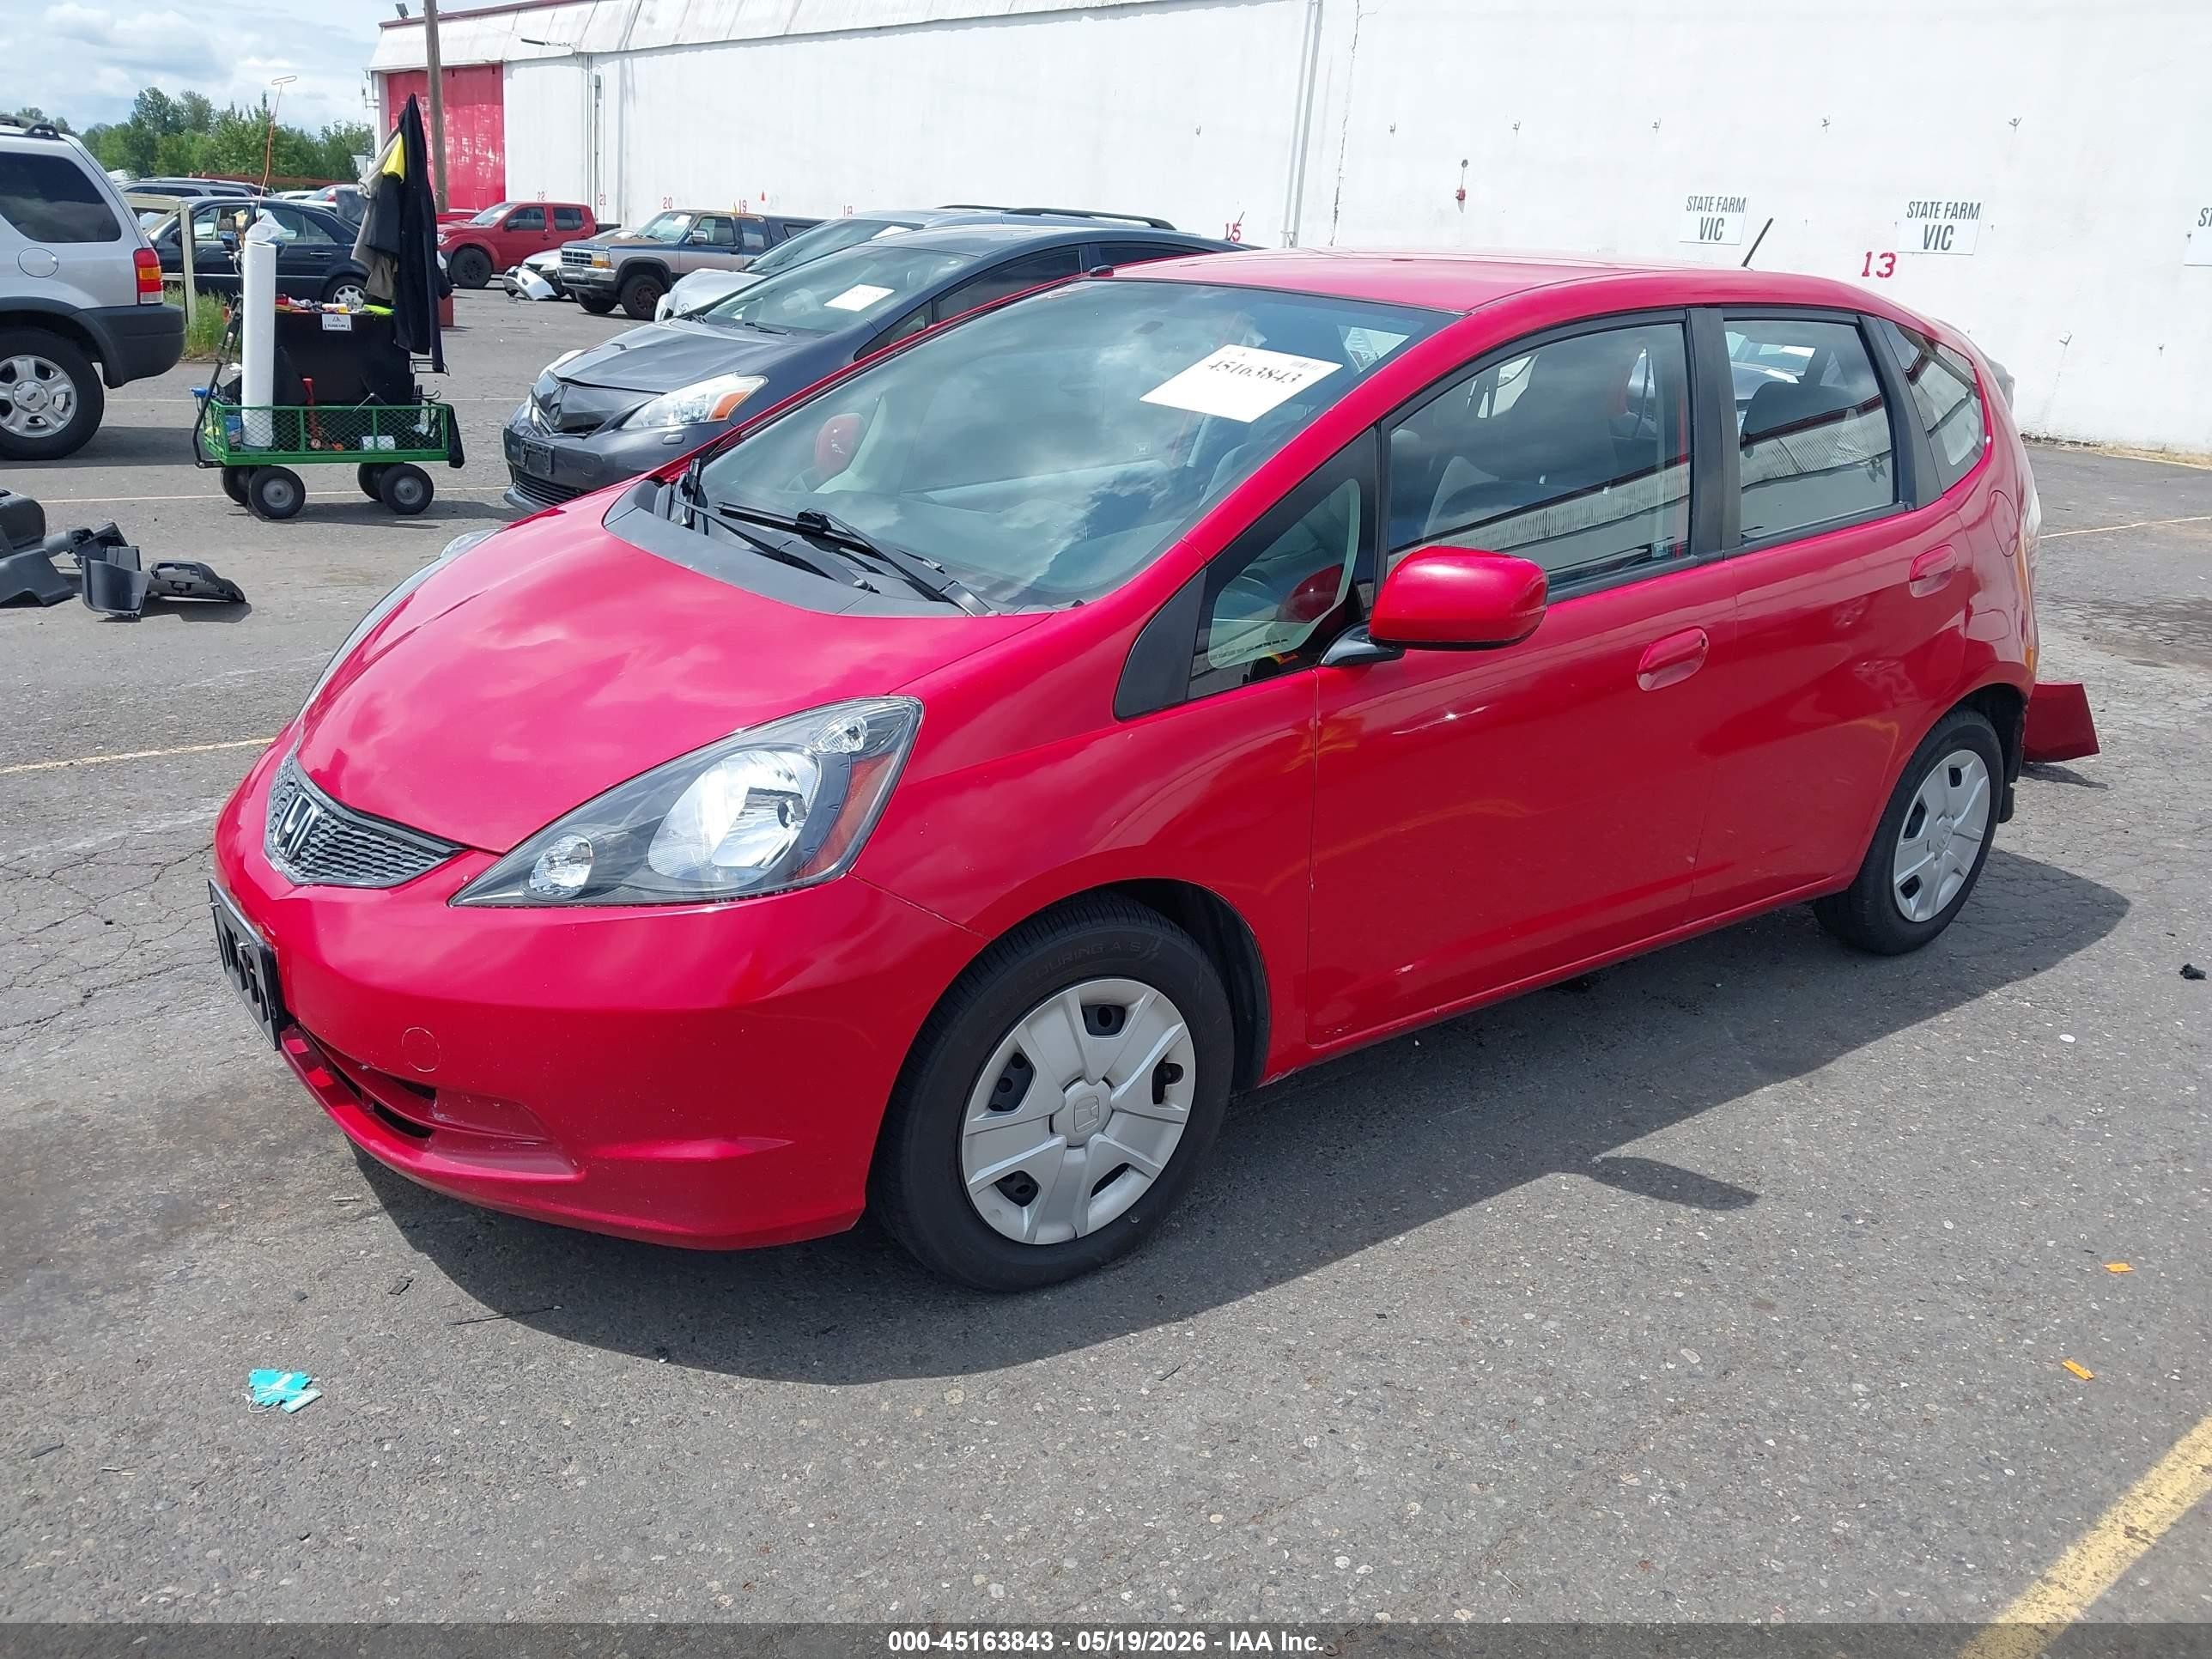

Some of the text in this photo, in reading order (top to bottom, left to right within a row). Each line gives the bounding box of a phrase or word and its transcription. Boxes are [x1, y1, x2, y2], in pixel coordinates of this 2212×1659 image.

[537, 191, 545, 201] 22
[662, 197, 673, 210] 20
[1686, 196, 1747, 213] STATE FARM
[738, 198, 748, 214] 19
[1906, 201, 1982, 220] STATE FARM
[1225, 222, 1242, 242] 15
[1699, 216, 1725, 241] VIC
[1923, 224, 1954, 251] VIC
[1861, 251, 1897, 278] 13
[1207, 360, 1304, 384] 45163843
